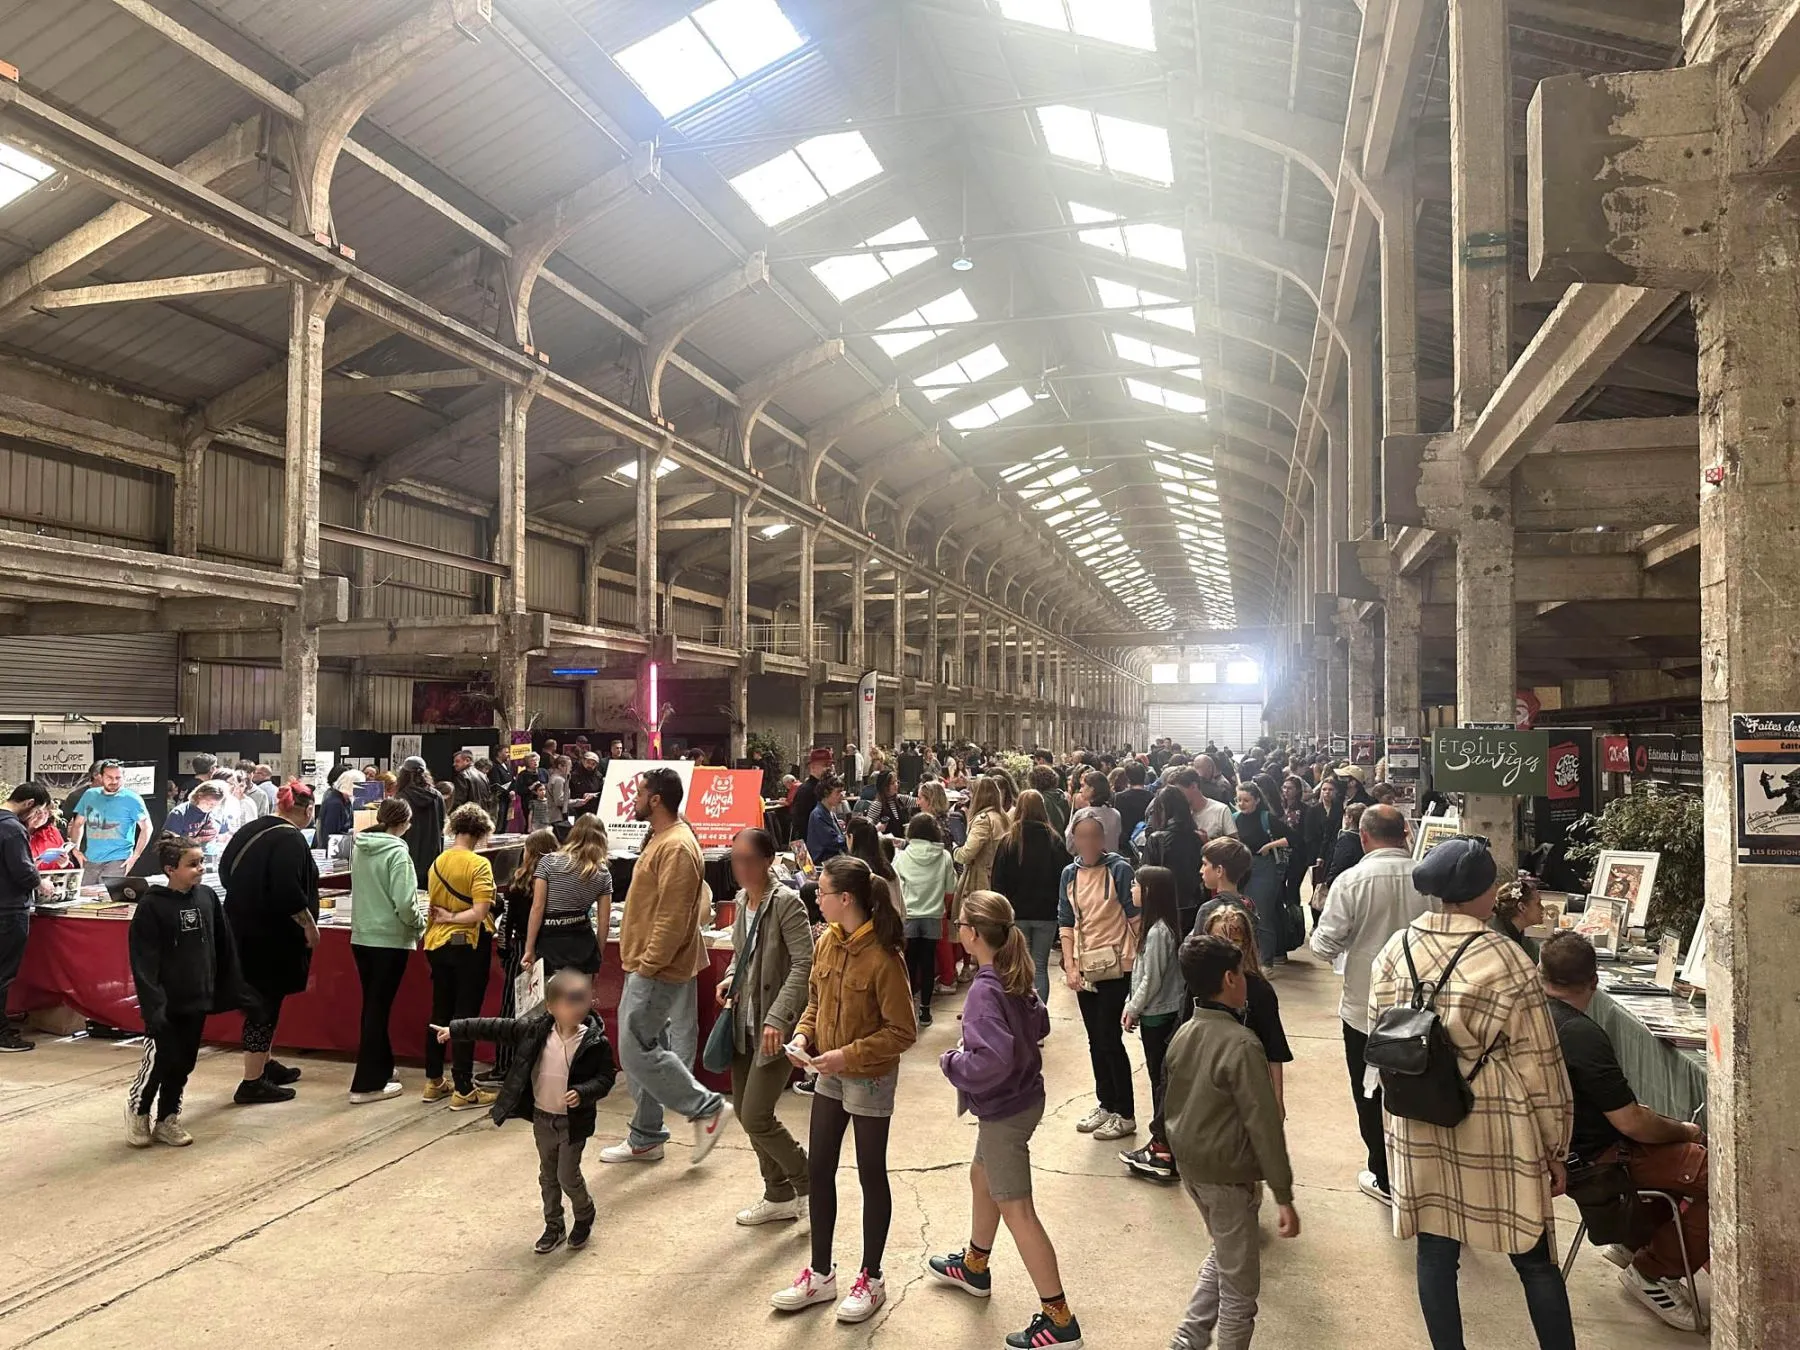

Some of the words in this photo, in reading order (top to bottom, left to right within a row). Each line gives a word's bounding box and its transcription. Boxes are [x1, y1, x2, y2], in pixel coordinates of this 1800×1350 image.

[1746, 718, 1782, 733] Faites
[1439, 736, 1518, 755] ÉTOILES
[1670, 749, 1679, 761] du
[38, 763, 87, 772] CONTREVENT
[1445, 747, 1541, 787] Sauvages
[701, 790, 734, 807] MANGA
[705, 803, 730, 818] KAT
